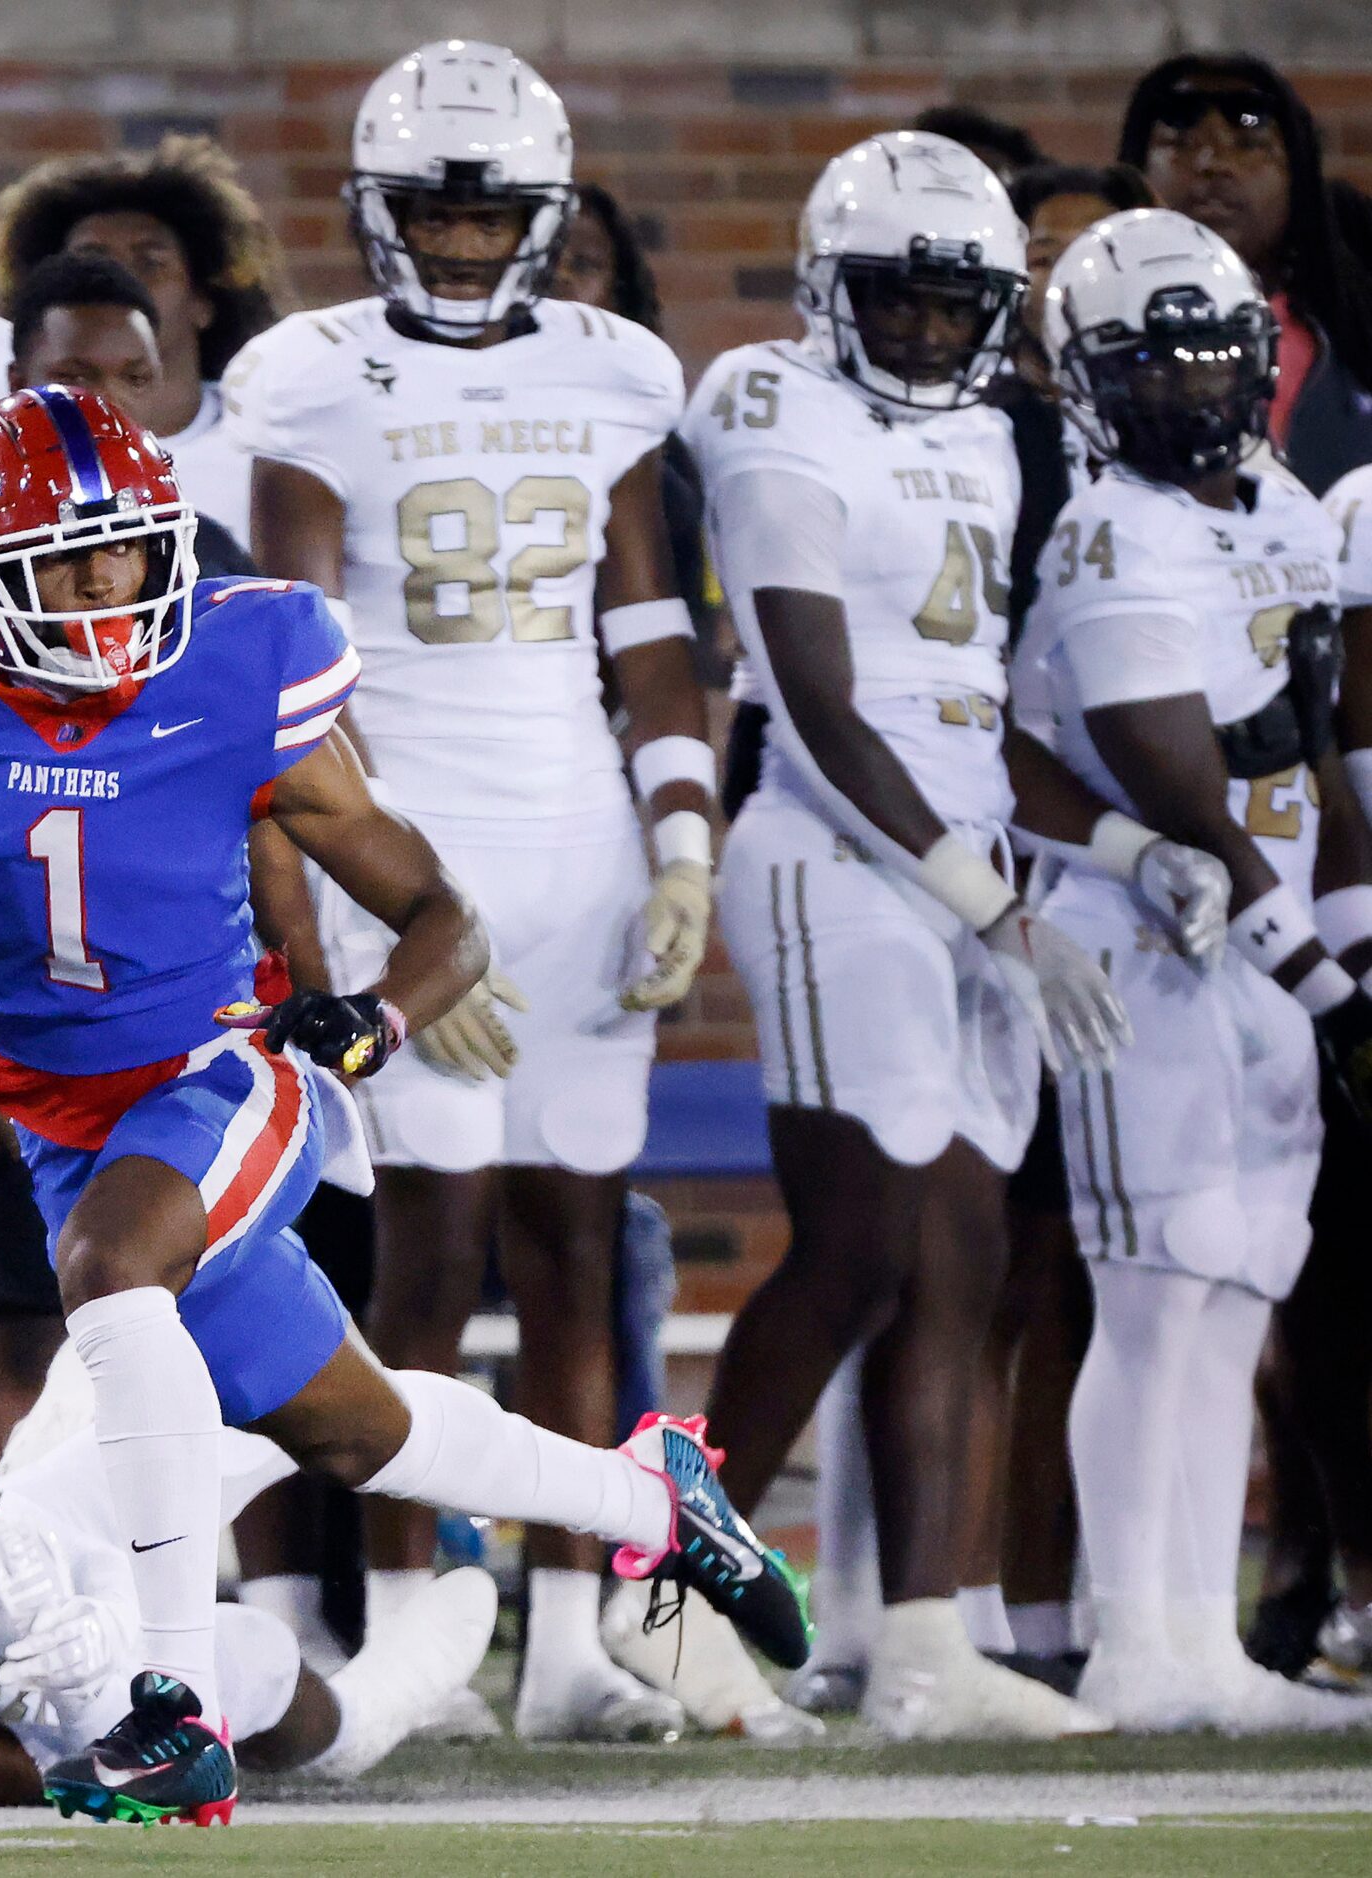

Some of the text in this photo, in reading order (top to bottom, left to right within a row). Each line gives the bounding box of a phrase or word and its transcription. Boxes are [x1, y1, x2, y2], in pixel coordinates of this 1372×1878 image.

[711, 371, 781, 430] 45
[382, 419, 594, 462] THE MECCA
[397, 475, 592, 645] 82
[1051, 519, 1117, 588] 34
[7, 760, 121, 800] PANTHERS
[24, 805, 110, 993] 1
